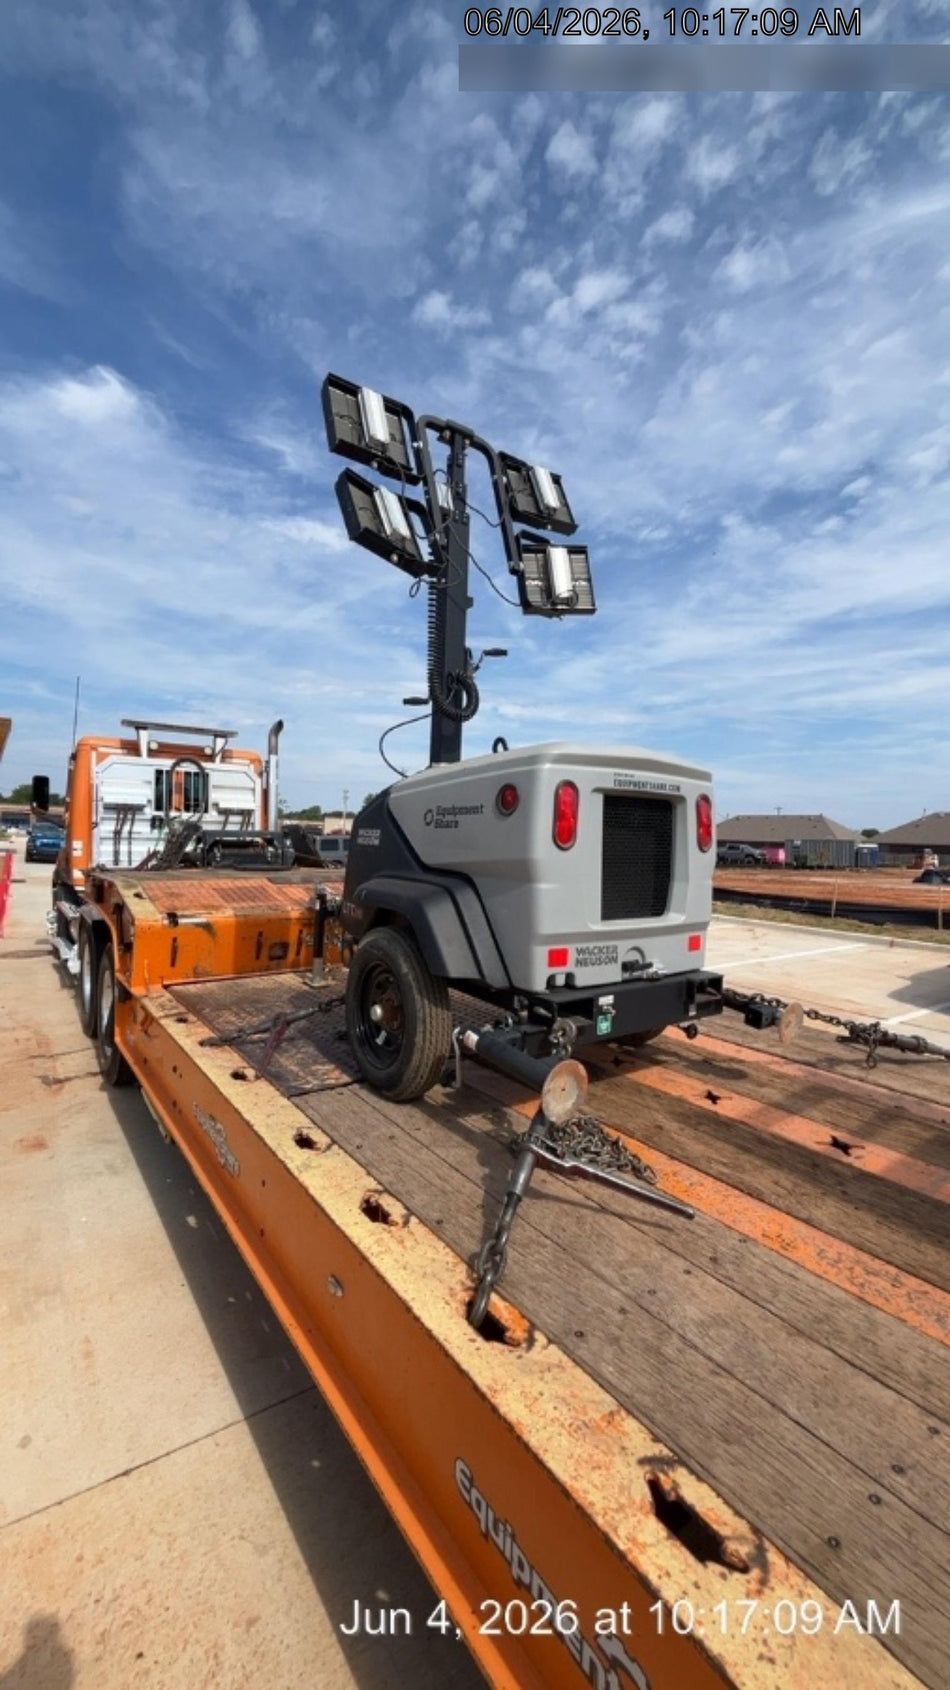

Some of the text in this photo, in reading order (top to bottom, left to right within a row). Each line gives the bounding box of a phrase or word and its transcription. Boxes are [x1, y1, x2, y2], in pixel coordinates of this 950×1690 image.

[435, 804, 484, 818] Equipment
[434, 818, 459, 829] Share
[575, 945, 618, 957] WACKER
[575, 955, 618, 967] NEUSON
